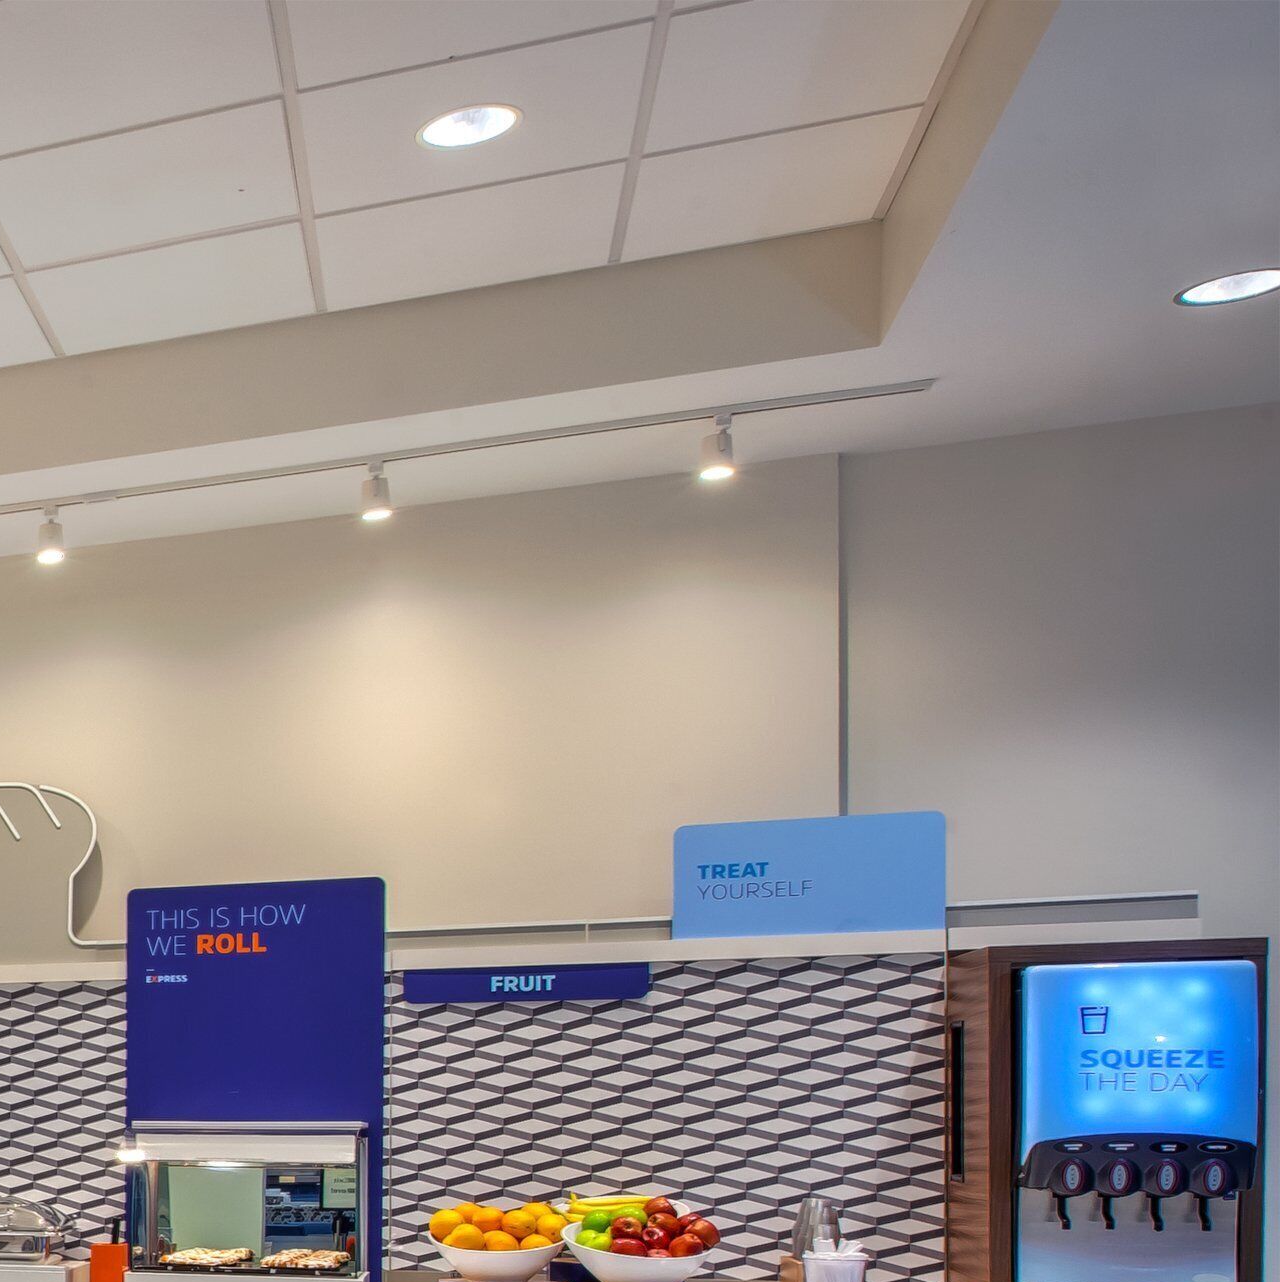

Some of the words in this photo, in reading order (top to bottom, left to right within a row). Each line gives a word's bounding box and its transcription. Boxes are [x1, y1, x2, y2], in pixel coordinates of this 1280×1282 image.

[697, 862, 769, 880] TREAT
[697, 880, 813, 900] YOURSELF
[146, 908, 200, 930] THIS
[210, 907, 230, 928] IS
[240, 904, 306, 926] HOW
[146, 935, 187, 956] WE
[196, 932, 268, 955] ROLL
[145, 975, 188, 984] EXPRESS
[490, 975, 556, 993] FRUIT
[1079, 1049, 1225, 1070] SQUEEZE
[1078, 1072, 1137, 1092] THE
[1149, 1072, 1209, 1092] DAY
